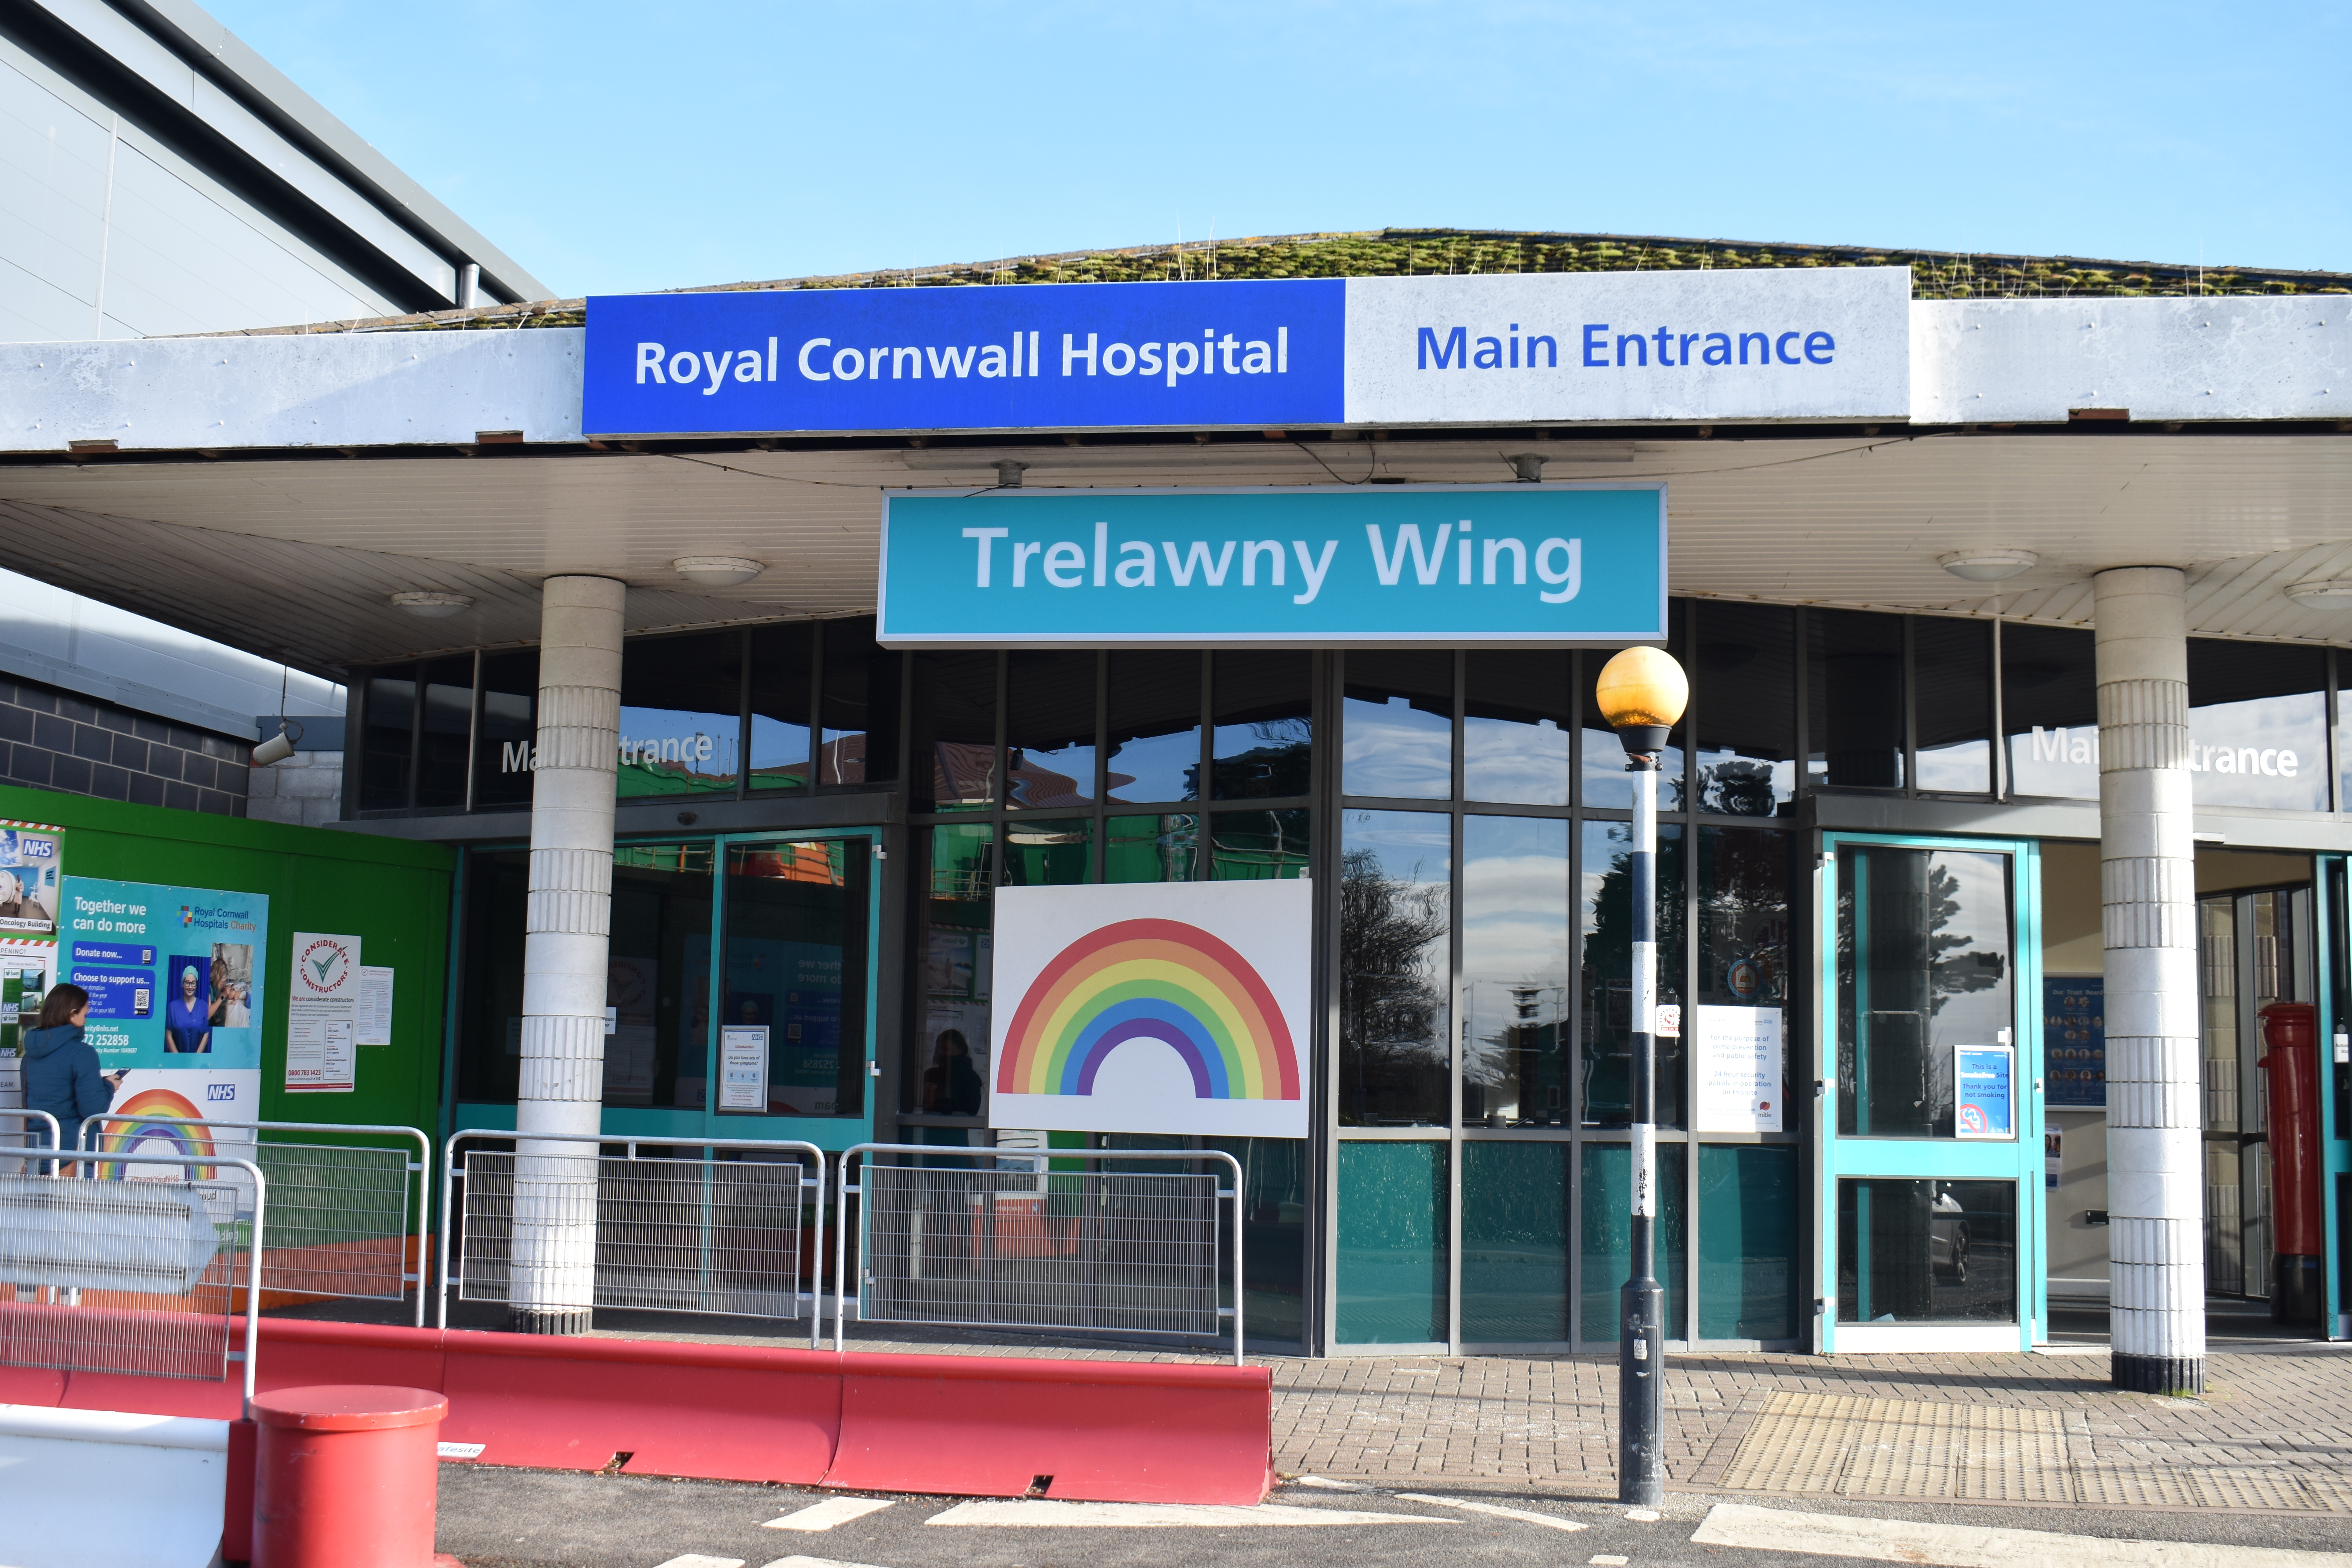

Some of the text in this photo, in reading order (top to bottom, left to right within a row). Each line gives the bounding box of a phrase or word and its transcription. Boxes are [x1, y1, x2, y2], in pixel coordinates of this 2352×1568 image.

[1418, 324, 1835, 370] Main Entrance
[636, 327, 1287, 396] Royal Cornwall Hospital
[962, 520, 1581, 604] Trelawny Wing
[502, 735, 713, 773] Ma trance
[2031, 725, 2298, 778] Mai trance
[24, 840, 53, 857] NHS
[75, 896, 147, 916] Together we
[195, 906, 249, 919] Royal Cornwall
[28, 920, 51, 929] Building
[73, 917, 146, 934] can do more
[194, 918, 256, 933] Hospitals Charity
[76, 947, 100, 957] Donate
[301, 940, 349, 965] CONSIDERATE
[74, 972, 98, 982] Choose
[109, 975, 135, 985] support
[300, 968, 348, 993] CONSTRUCTORS
[3, 1004, 19, 1012] NHS
[96, 1034, 129, 1045] 252858
[0, 1049, 16, 1057] NHS
[1748, 1053, 1767, 1061] safety
[1741, 1071, 1766, 1080] security
[209, 1085, 235, 1100] NHS
[131, 1174, 180, 1183] #ThankYouNHS
